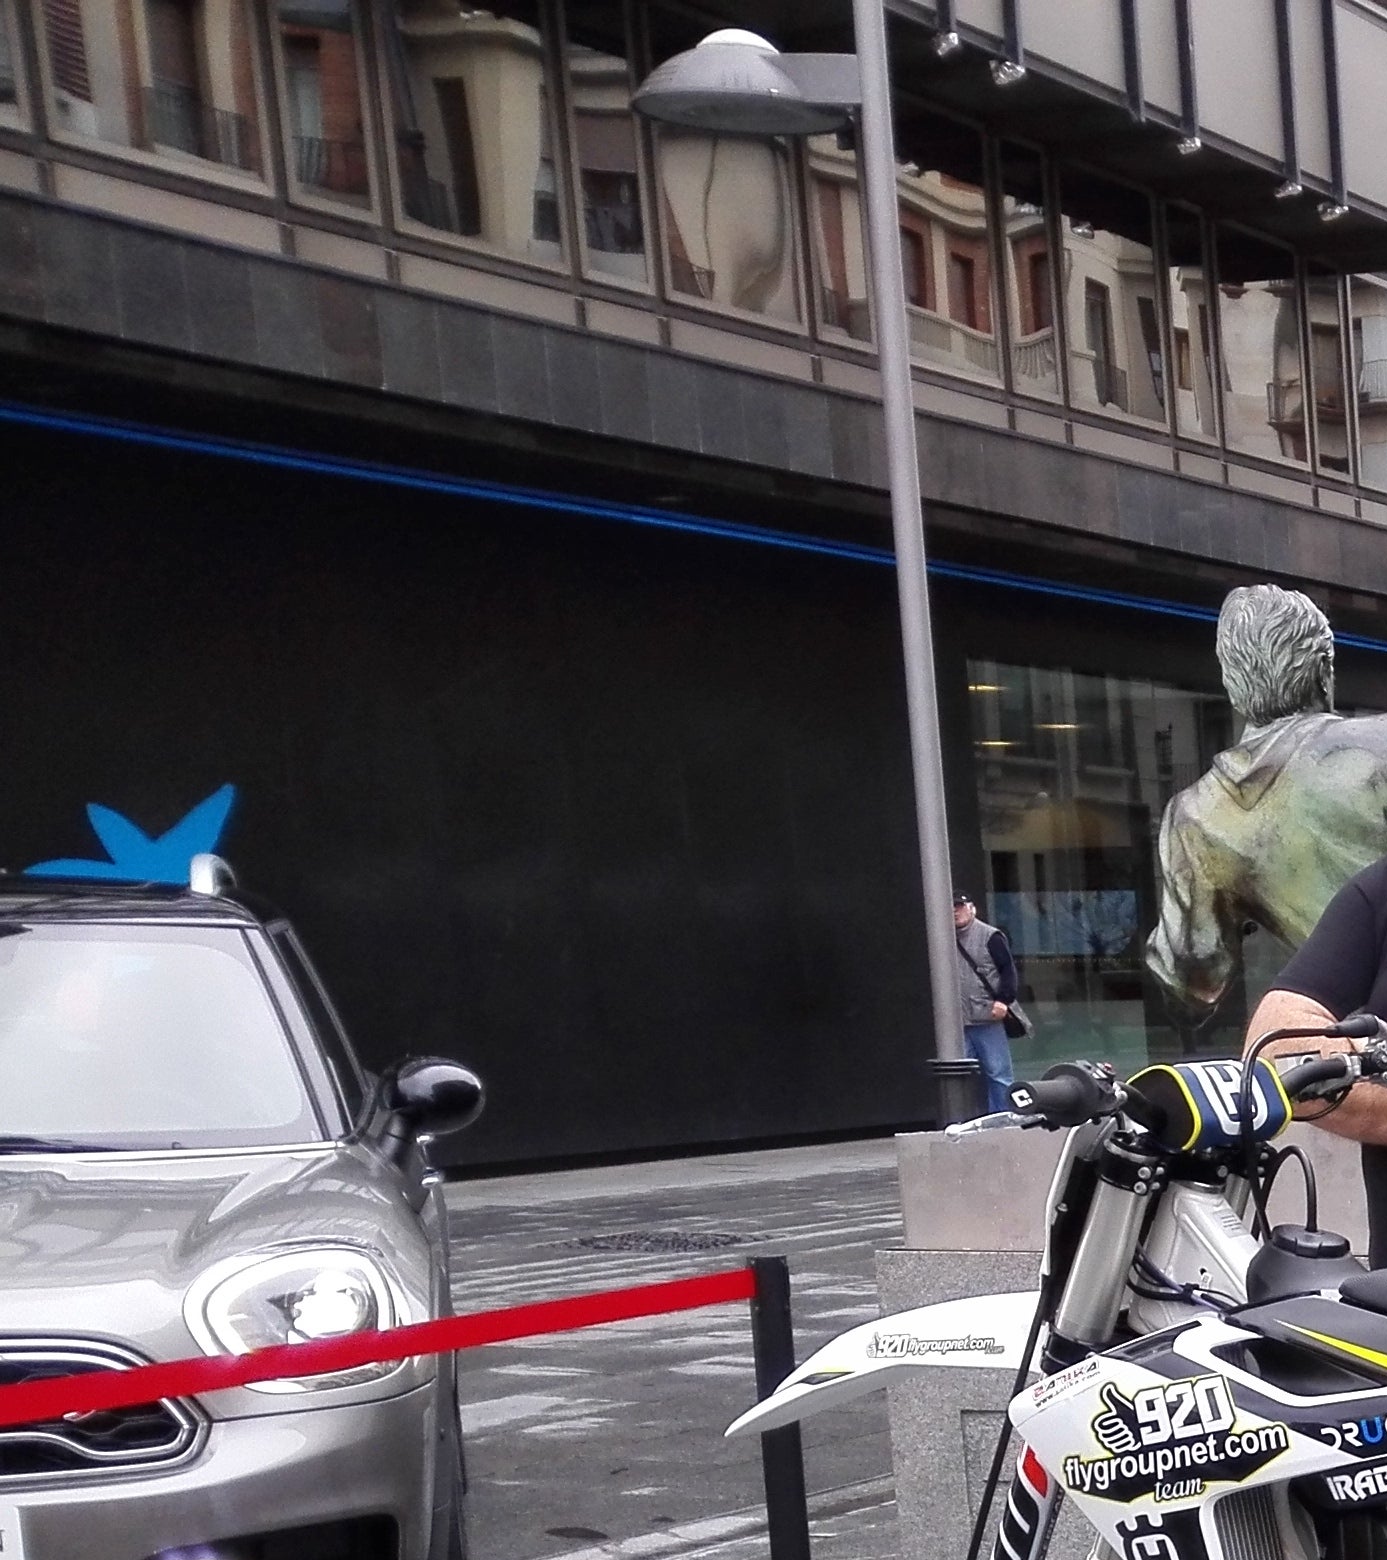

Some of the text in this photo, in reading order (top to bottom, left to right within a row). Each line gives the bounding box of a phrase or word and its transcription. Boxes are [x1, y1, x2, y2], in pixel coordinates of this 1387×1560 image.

[878, 1334, 911, 1358] 920
[1132, 1374, 1235, 1447] 920
[1064, 1424, 1288, 1492] flygroupnet.com
[1154, 1477, 1205, 1502] team
